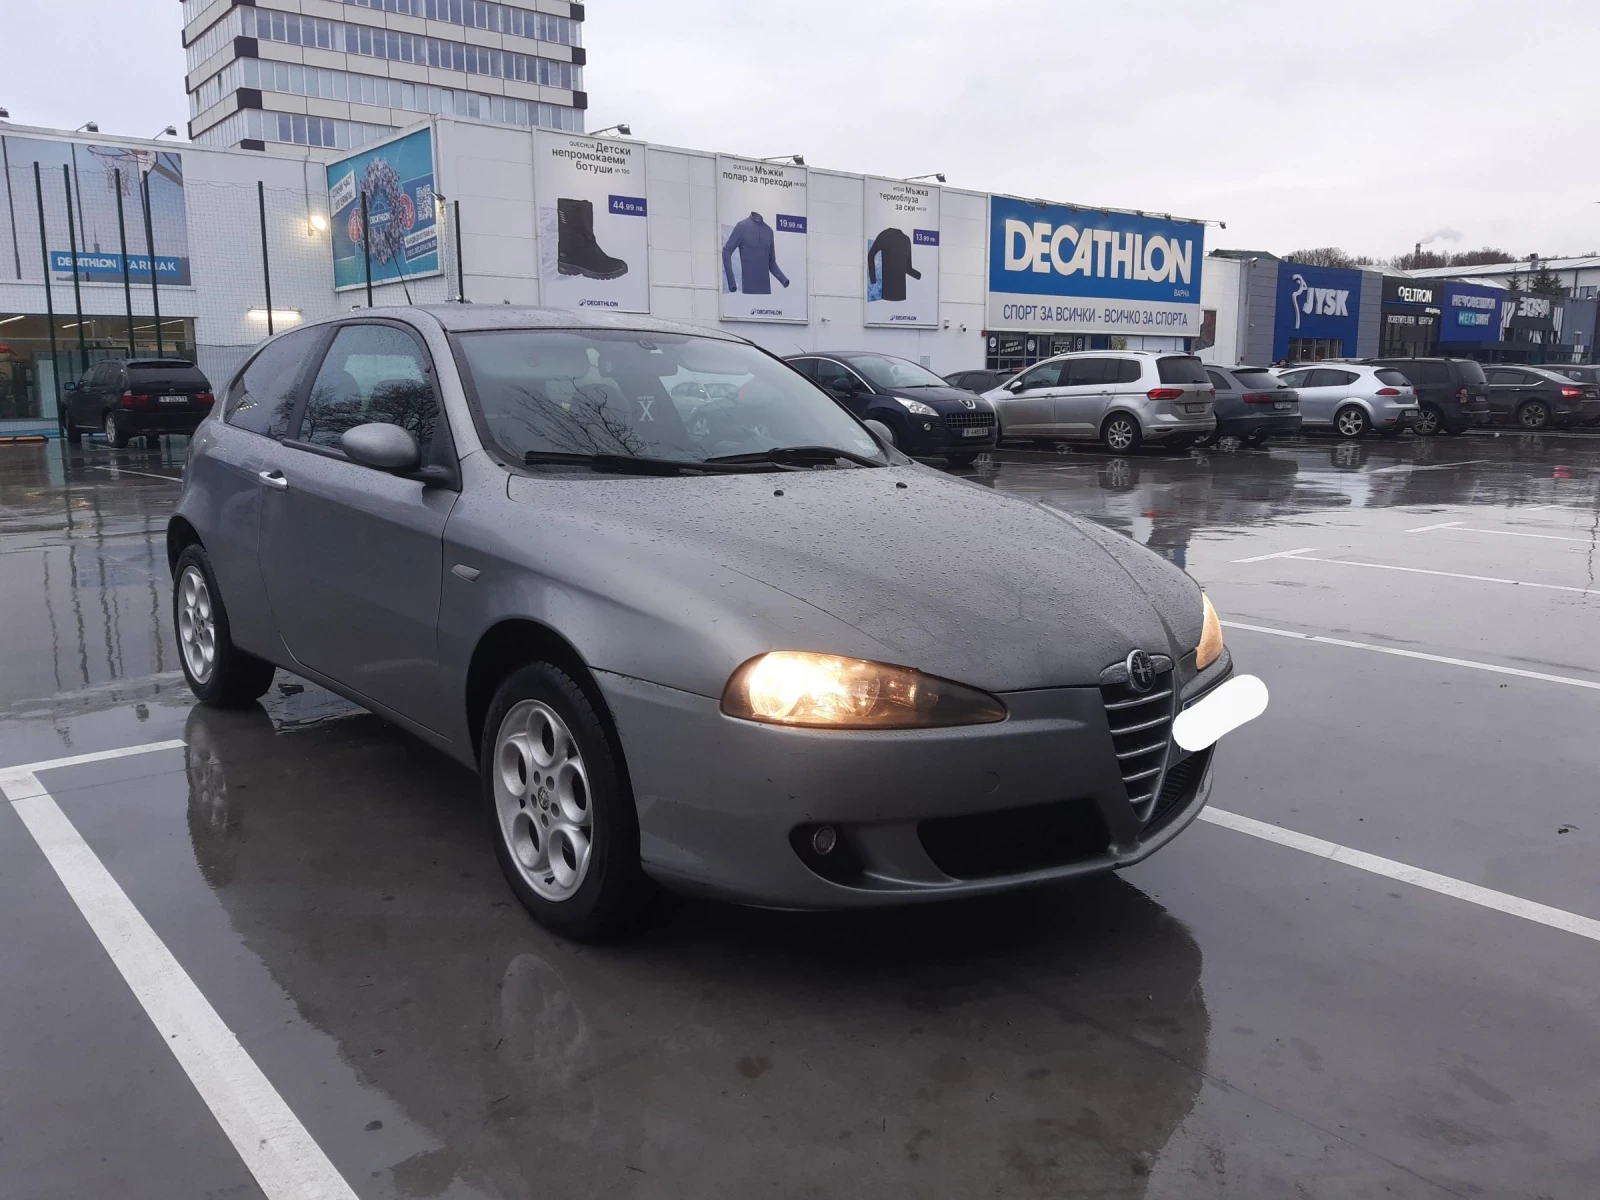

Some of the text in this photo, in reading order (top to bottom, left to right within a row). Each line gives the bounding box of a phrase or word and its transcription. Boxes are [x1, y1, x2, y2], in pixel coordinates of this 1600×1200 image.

[569, 140, 631, 156] QUECHUA Детски
[552, 148, 626, 165] непромокаеми
[575, 160, 613, 174] ботуши
[754, 165, 784, 177] Мъжки
[722, 171, 748, 183] полар
[749, 175, 758, 183] за
[760, 177, 793, 188] преходи
[905, 186, 929, 197] Мъжка
[879, 192, 919, 204] термоблуза
[612, 200, 634, 211] 44.99
[895, 203, 903, 211] за
[903, 204, 916, 212] ски
[779, 219, 796, 229] 19.99
[1004, 218, 1193, 284] DECATHLON
[122, 259, 176, 271] ARMAK
[1173, 289, 1190, 297] ВАРНА
[586, 299, 619, 307] DECATHLON
[1302, 287, 1350, 317] JYSK
[1003, 304, 1038, 321] СПОРТ
[1040, 305, 1053, 321] ЗА
[1055, 306, 1096, 323] ВСИЧКИ
[1104, 308, 1140, 325] ВСИЧКО
[1142, 310, 1153, 325] ЗА
[1155, 310, 1188, 326] СПОРТА
